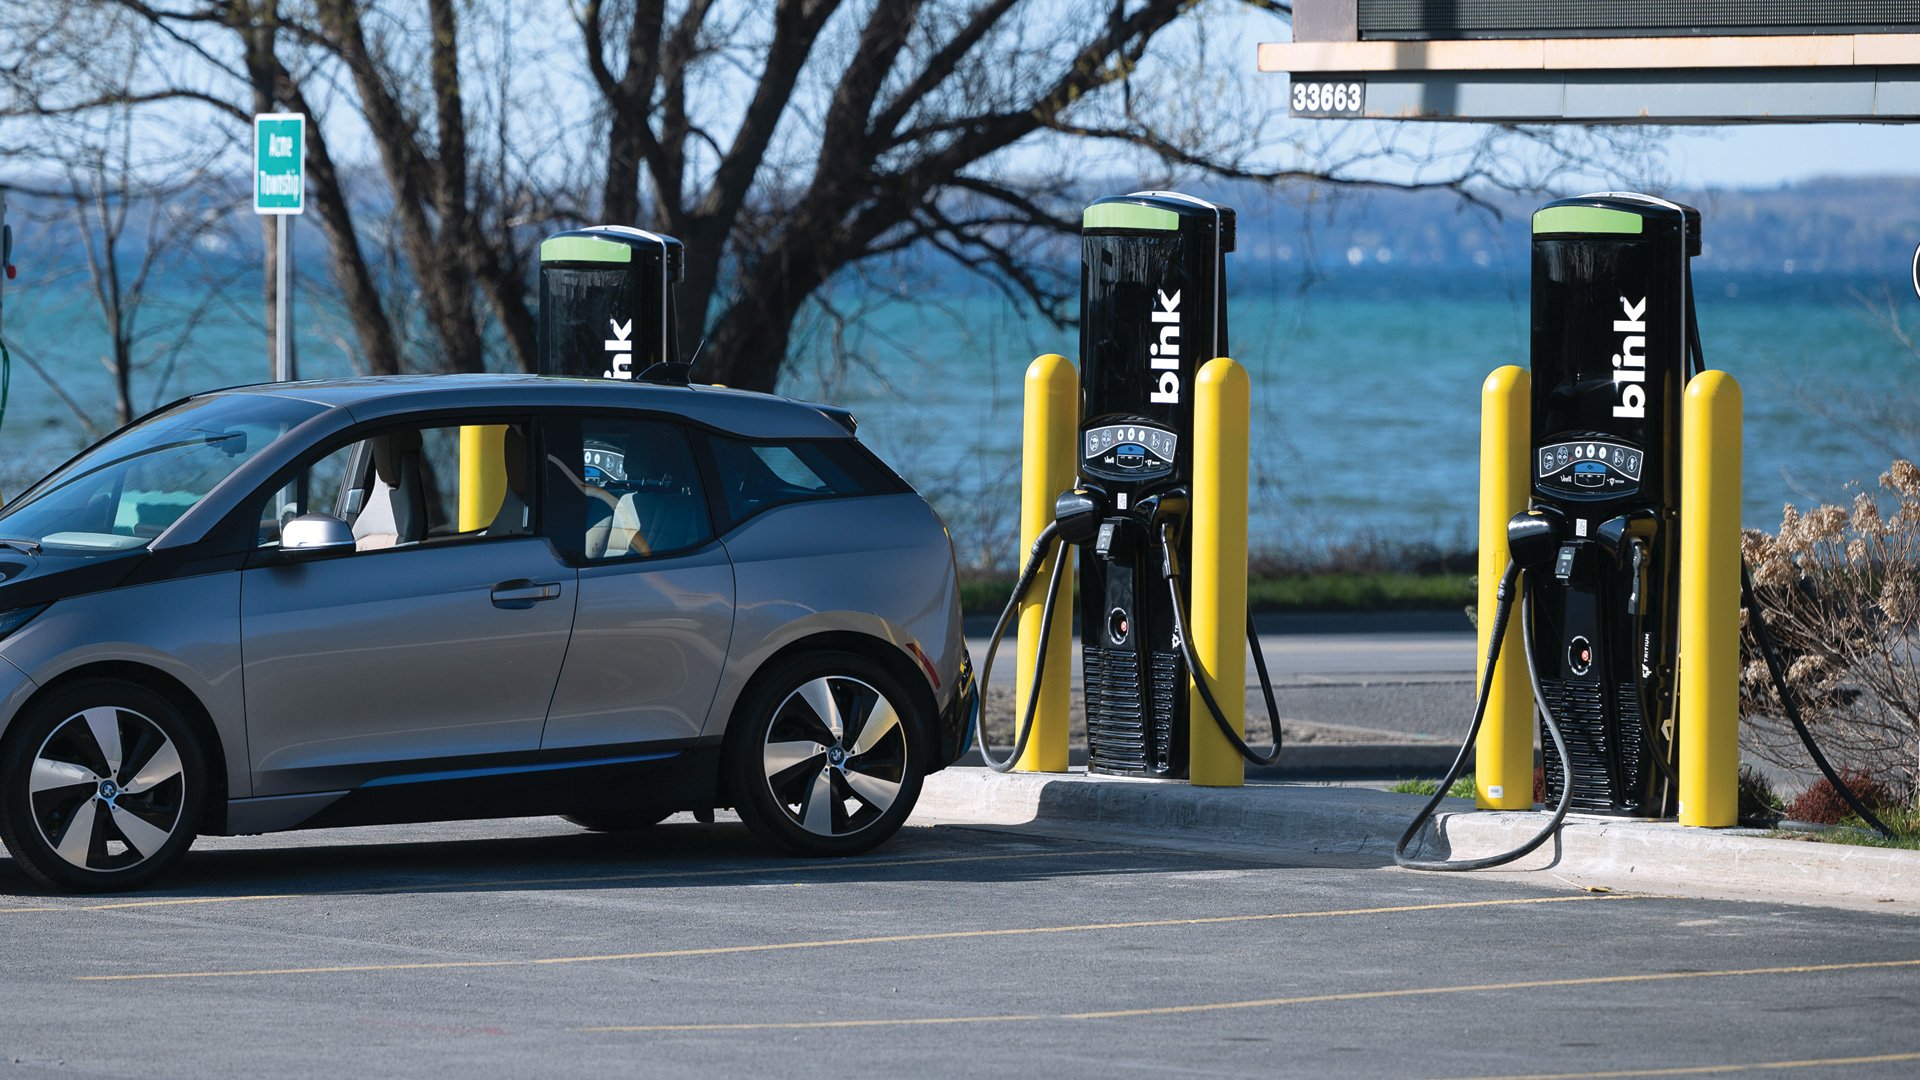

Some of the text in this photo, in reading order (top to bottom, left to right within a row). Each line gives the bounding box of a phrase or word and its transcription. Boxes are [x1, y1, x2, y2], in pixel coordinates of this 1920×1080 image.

[1292, 83, 1361, 112] 33663
[1149, 288, 1181, 404] blink
[1611, 296, 1646, 418] blink
